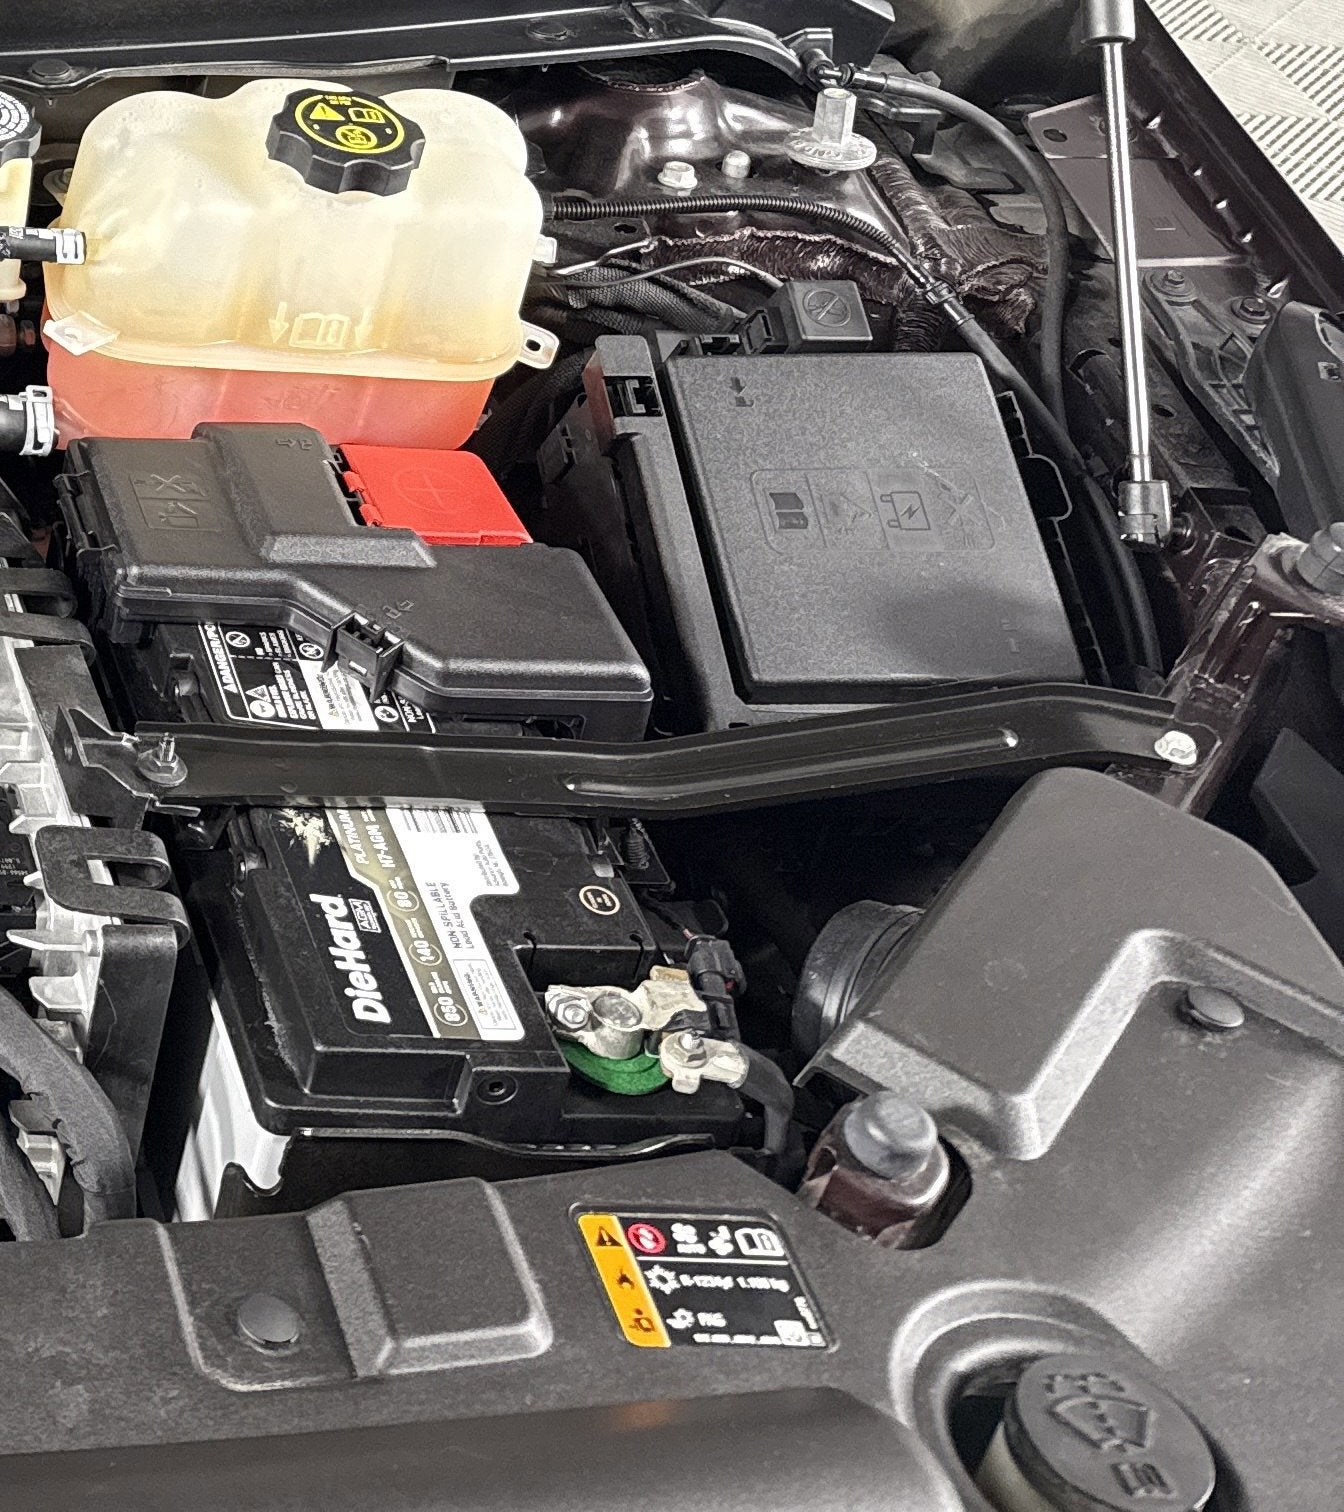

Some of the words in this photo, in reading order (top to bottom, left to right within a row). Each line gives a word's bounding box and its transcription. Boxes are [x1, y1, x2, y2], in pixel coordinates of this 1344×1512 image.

[365, 824, 396, 868] H7-AGM
[393, 891, 413, 908] 80
[440, 882, 458, 911] Battery
[308, 893, 392, 1024] DieHard
[413, 939, 435, 962] 140
[437, 996, 462, 1023] 850
